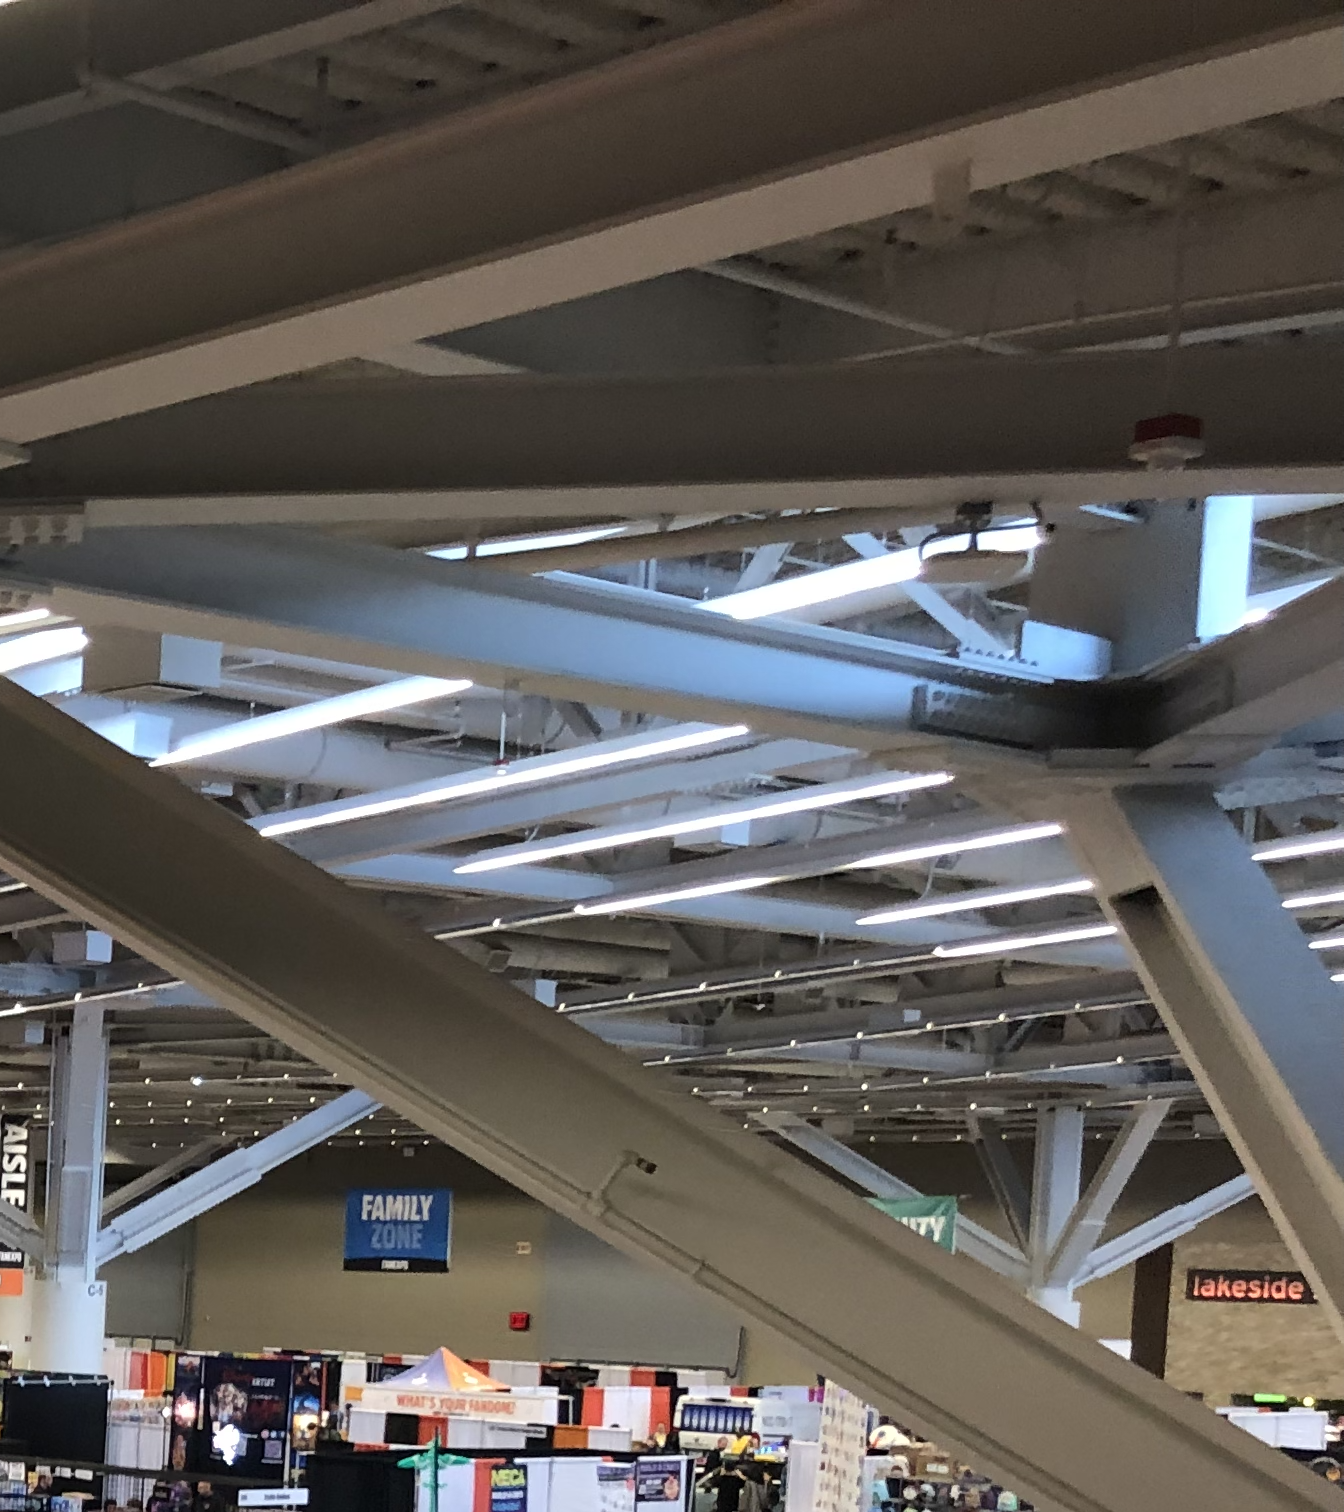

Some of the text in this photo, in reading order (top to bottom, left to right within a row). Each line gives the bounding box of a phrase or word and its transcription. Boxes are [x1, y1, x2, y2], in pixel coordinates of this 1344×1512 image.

[2, 1122, 29, 1207] AISLE
[361, 1194, 433, 1221] FAMILY
[370, 1222, 424, 1249] ZONE
[1192, 1275, 1305, 1300] lakeside
[397, 1395, 517, 1415] WHAT'S YOUR FANDOM?
